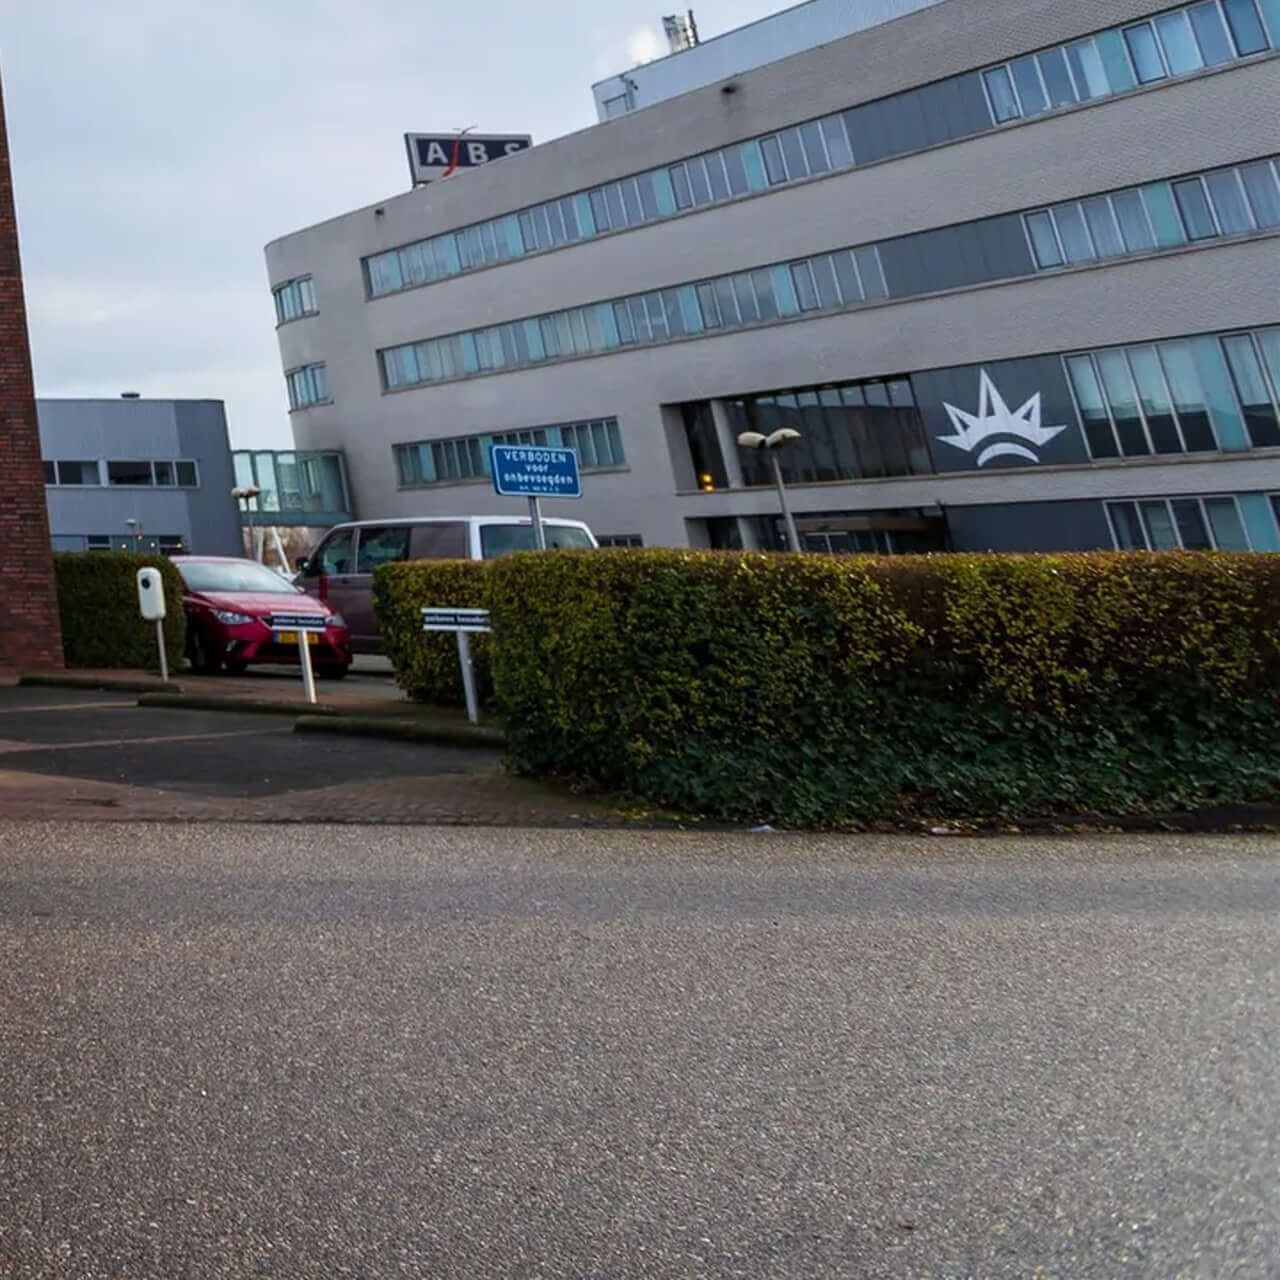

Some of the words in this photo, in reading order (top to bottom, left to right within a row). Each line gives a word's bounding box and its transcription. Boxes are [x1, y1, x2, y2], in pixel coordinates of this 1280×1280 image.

[503, 450, 567, 464] VERBODEN
[525, 464, 549, 473] voor
[503, 472, 574, 487] onbevoegden
